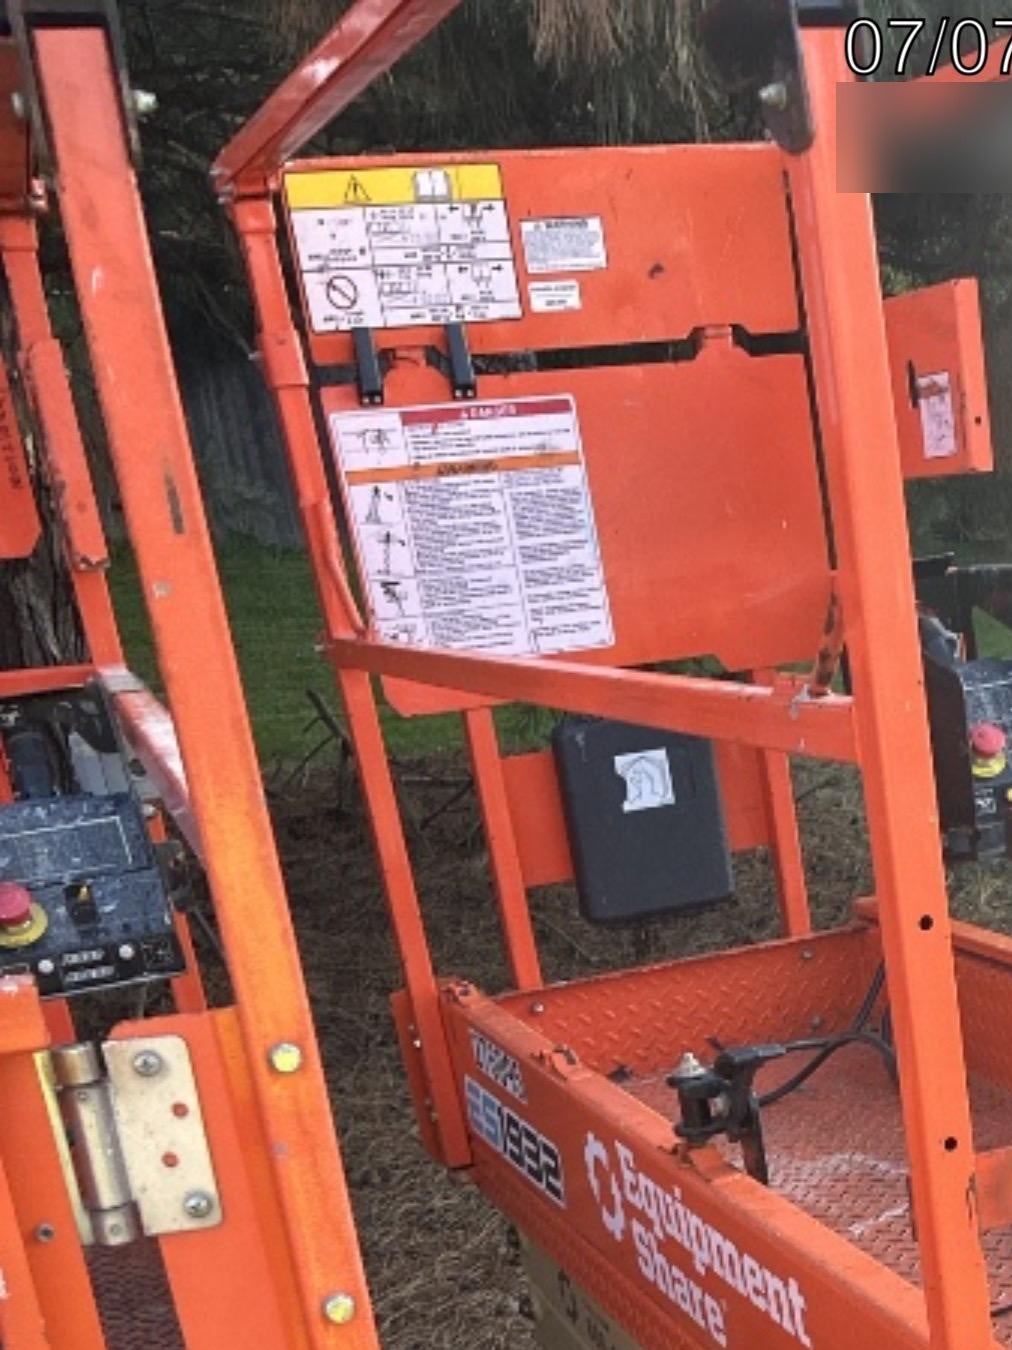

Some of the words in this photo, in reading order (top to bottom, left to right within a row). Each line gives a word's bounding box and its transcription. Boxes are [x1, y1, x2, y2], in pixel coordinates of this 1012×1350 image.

[467, 1082, 562, 1201] ES1932
[615, 1140, 814, 1350] Equipment
[632, 1218, 727, 1347] Share
